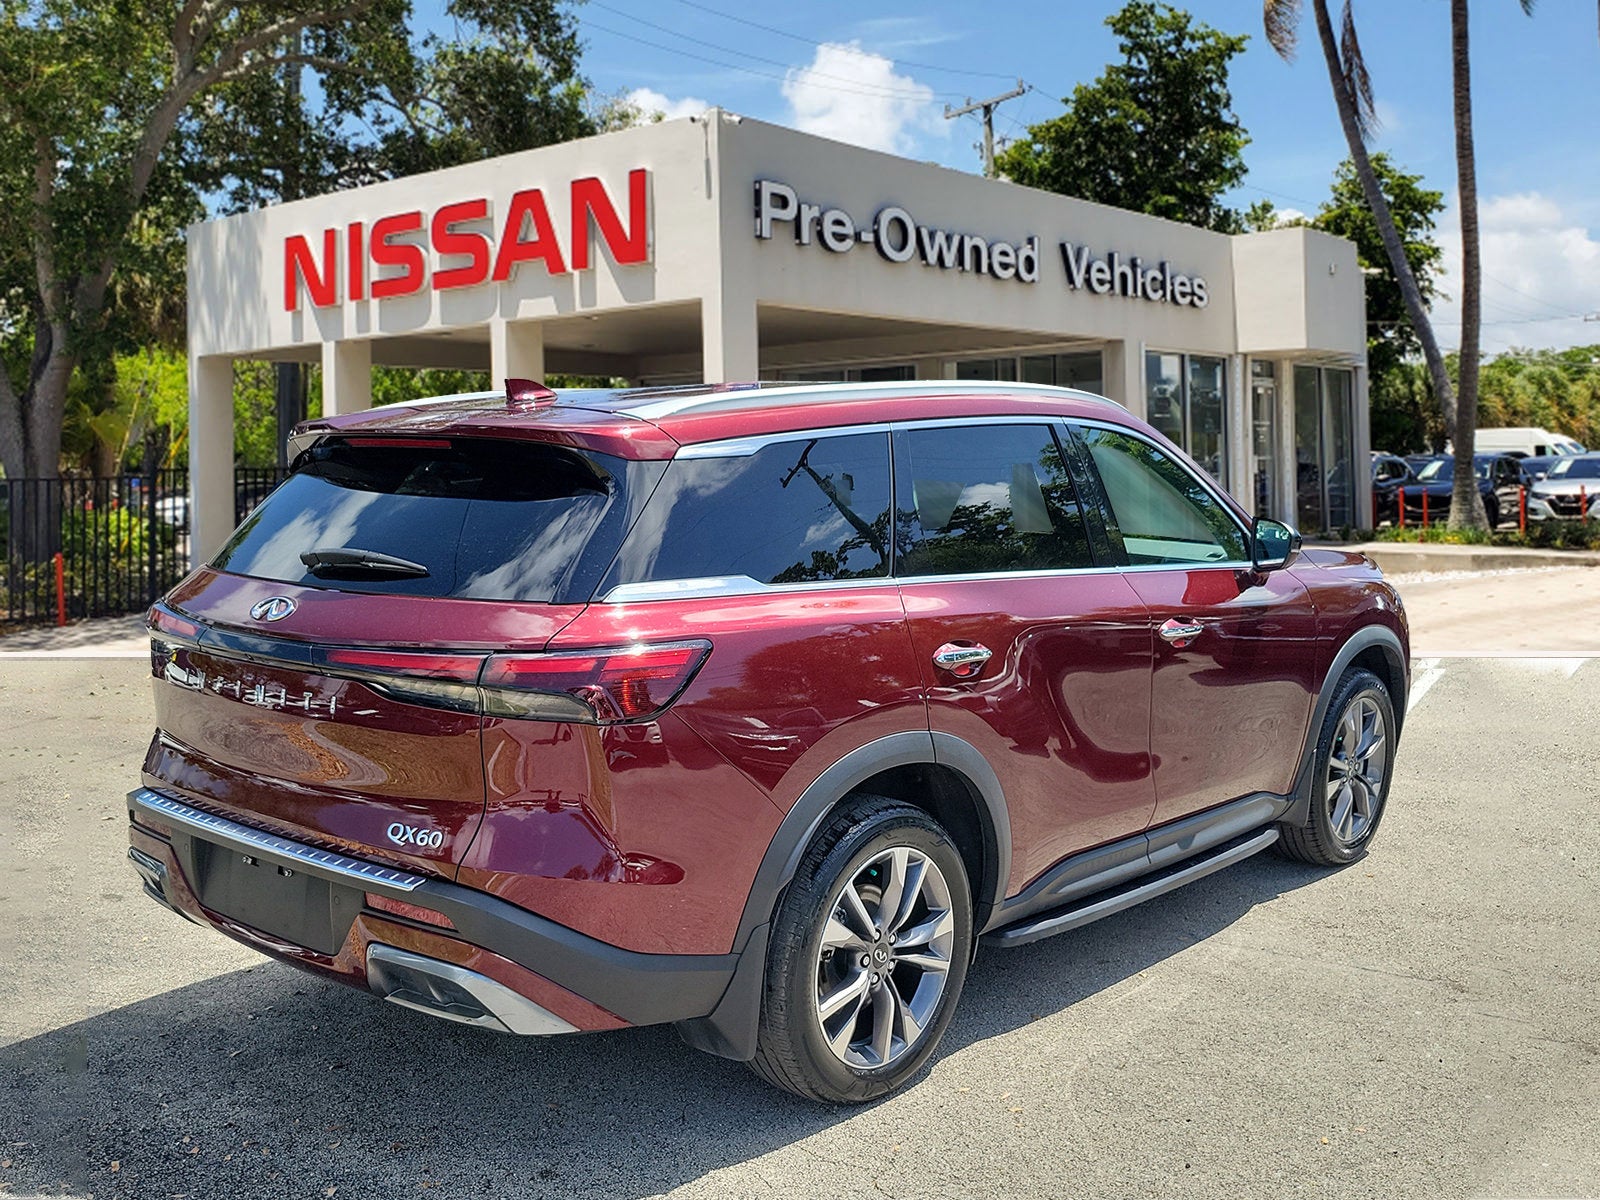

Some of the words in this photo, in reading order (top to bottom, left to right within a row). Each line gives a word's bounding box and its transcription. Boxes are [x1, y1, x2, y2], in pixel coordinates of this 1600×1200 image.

[284, 168, 647, 312] NISSAN
[755, 180, 1039, 283] Pre-Owned
[1060, 242, 1208, 308] Vehicles
[387, 822, 443, 849] QX60
